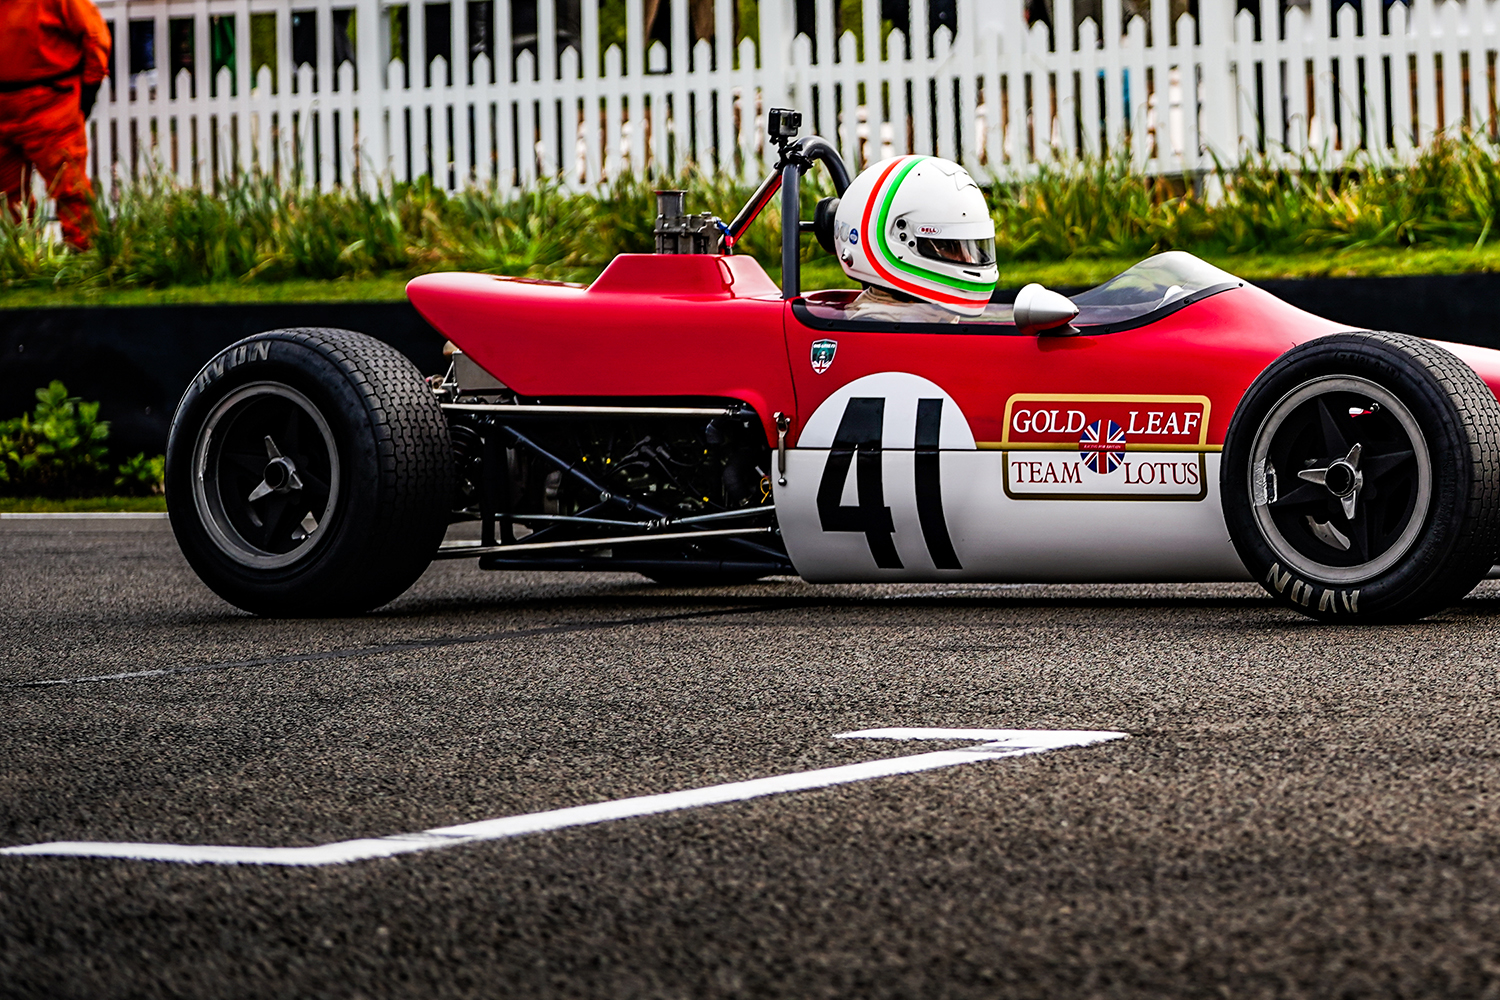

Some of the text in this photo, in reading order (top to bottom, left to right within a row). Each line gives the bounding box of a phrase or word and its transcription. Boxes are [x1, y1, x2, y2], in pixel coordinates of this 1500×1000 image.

[195, 341, 271, 394] AVON
[1012, 409, 1201, 435] GOLD LEAF
[816, 397, 963, 570] 41
[1011, 461, 1199, 485] TEAM LOTUS
[1265, 562, 1360, 614] AVON
